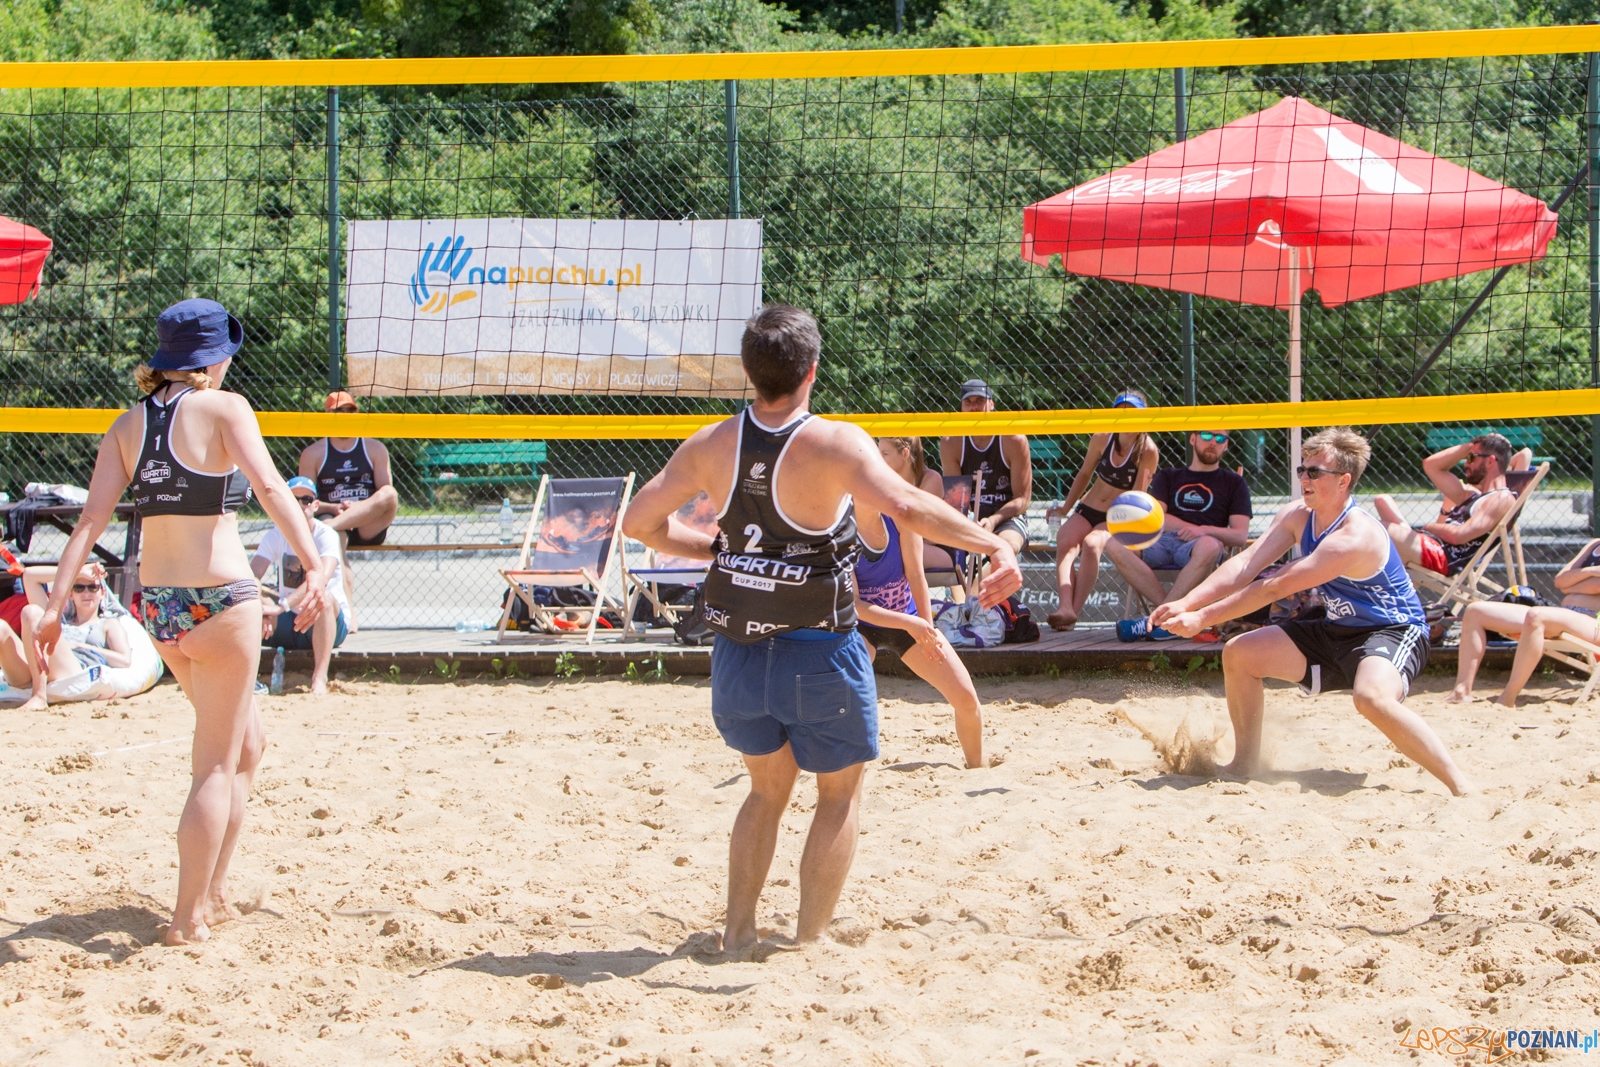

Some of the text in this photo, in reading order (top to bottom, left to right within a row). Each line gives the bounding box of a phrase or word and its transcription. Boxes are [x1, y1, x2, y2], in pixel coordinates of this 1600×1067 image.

[468, 263, 641, 292] napiachu.pl
[498, 373, 535, 384] BOISKA
[552, 373, 591, 385] NEWSY
[155, 434, 161, 451] 1
[142, 468, 169, 478] WARTA
[331, 488, 367, 498] WARTA
[744, 524, 763, 553] 2
[720, 553, 805, 580] WARTA
[735, 576, 772, 589] CUP 2017
